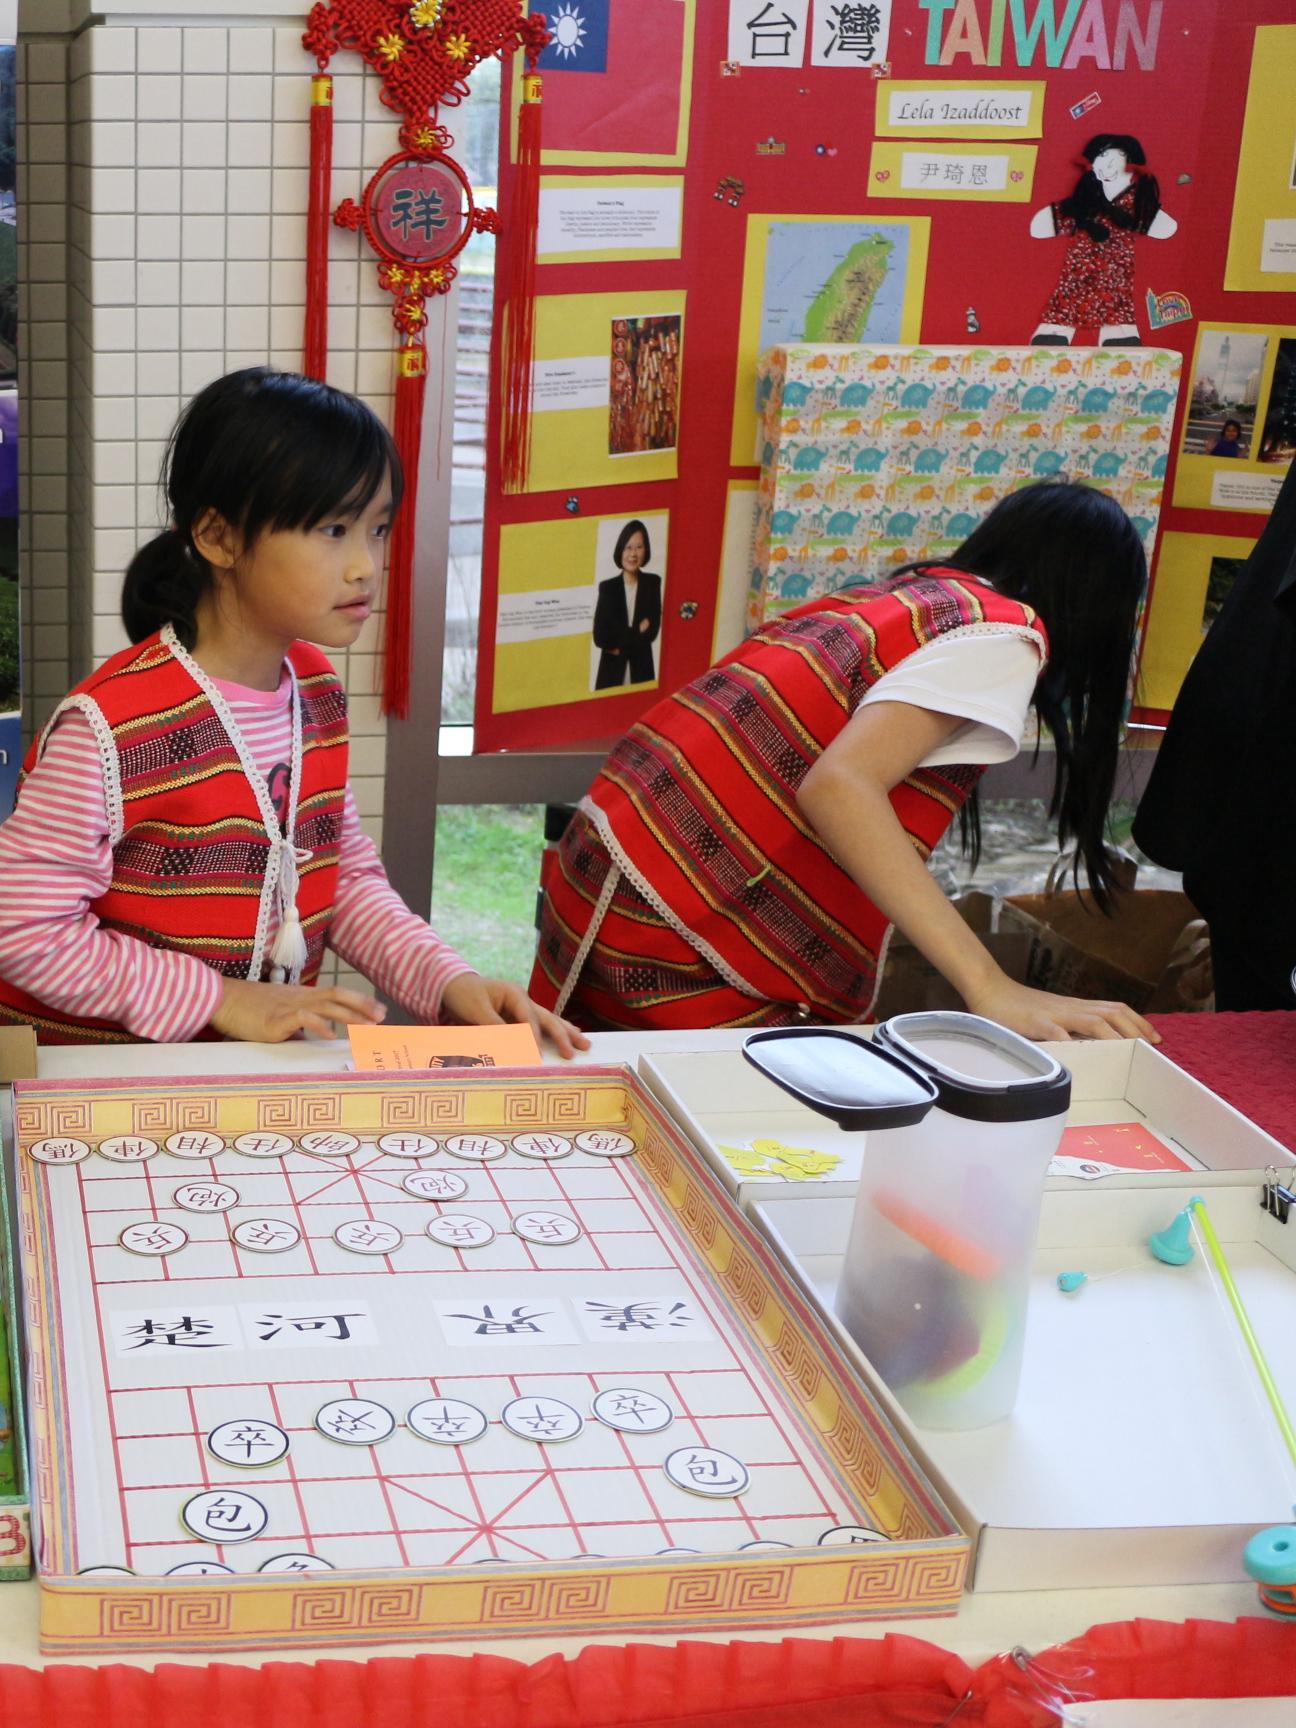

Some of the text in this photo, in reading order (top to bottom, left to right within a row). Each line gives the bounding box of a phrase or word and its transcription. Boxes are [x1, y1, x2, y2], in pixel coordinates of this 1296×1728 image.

[747, 2, 881, 61] 台灣
[918, 0, 1164, 70] TAIWAN
[897, 99, 1022, 120] Lela Izaddoost
[390, 188, 448, 241] 祥
[176, 1136, 216, 1155] 相
[243, 1137, 281, 1153] 仕
[391, 1138, 429, 1152] 仕
[458, 1139, 489, 1156] 相
[187, 1186, 229, 1208] 炮
[411, 1175, 456, 1194] 炮
[132, 1225, 173, 1250] 兵
[247, 1223, 292, 1246] 兵
[349, 1225, 394, 1247] 兵
[438, 1220, 481, 1241] 兵
[525, 1217, 566, 1238] 兵
[120, 1313, 367, 1350] 楚河
[422, 1405, 471, 1437] 卒
[517, 1404, 564, 1435] 卒
[614, 1394, 657, 1424] 卒
[328, 1408, 377, 1436] 卒
[225, 1426, 274, 1458] 卒
[687, 1454, 737, 1486] 包
[205, 1497, 252, 1533] 包
